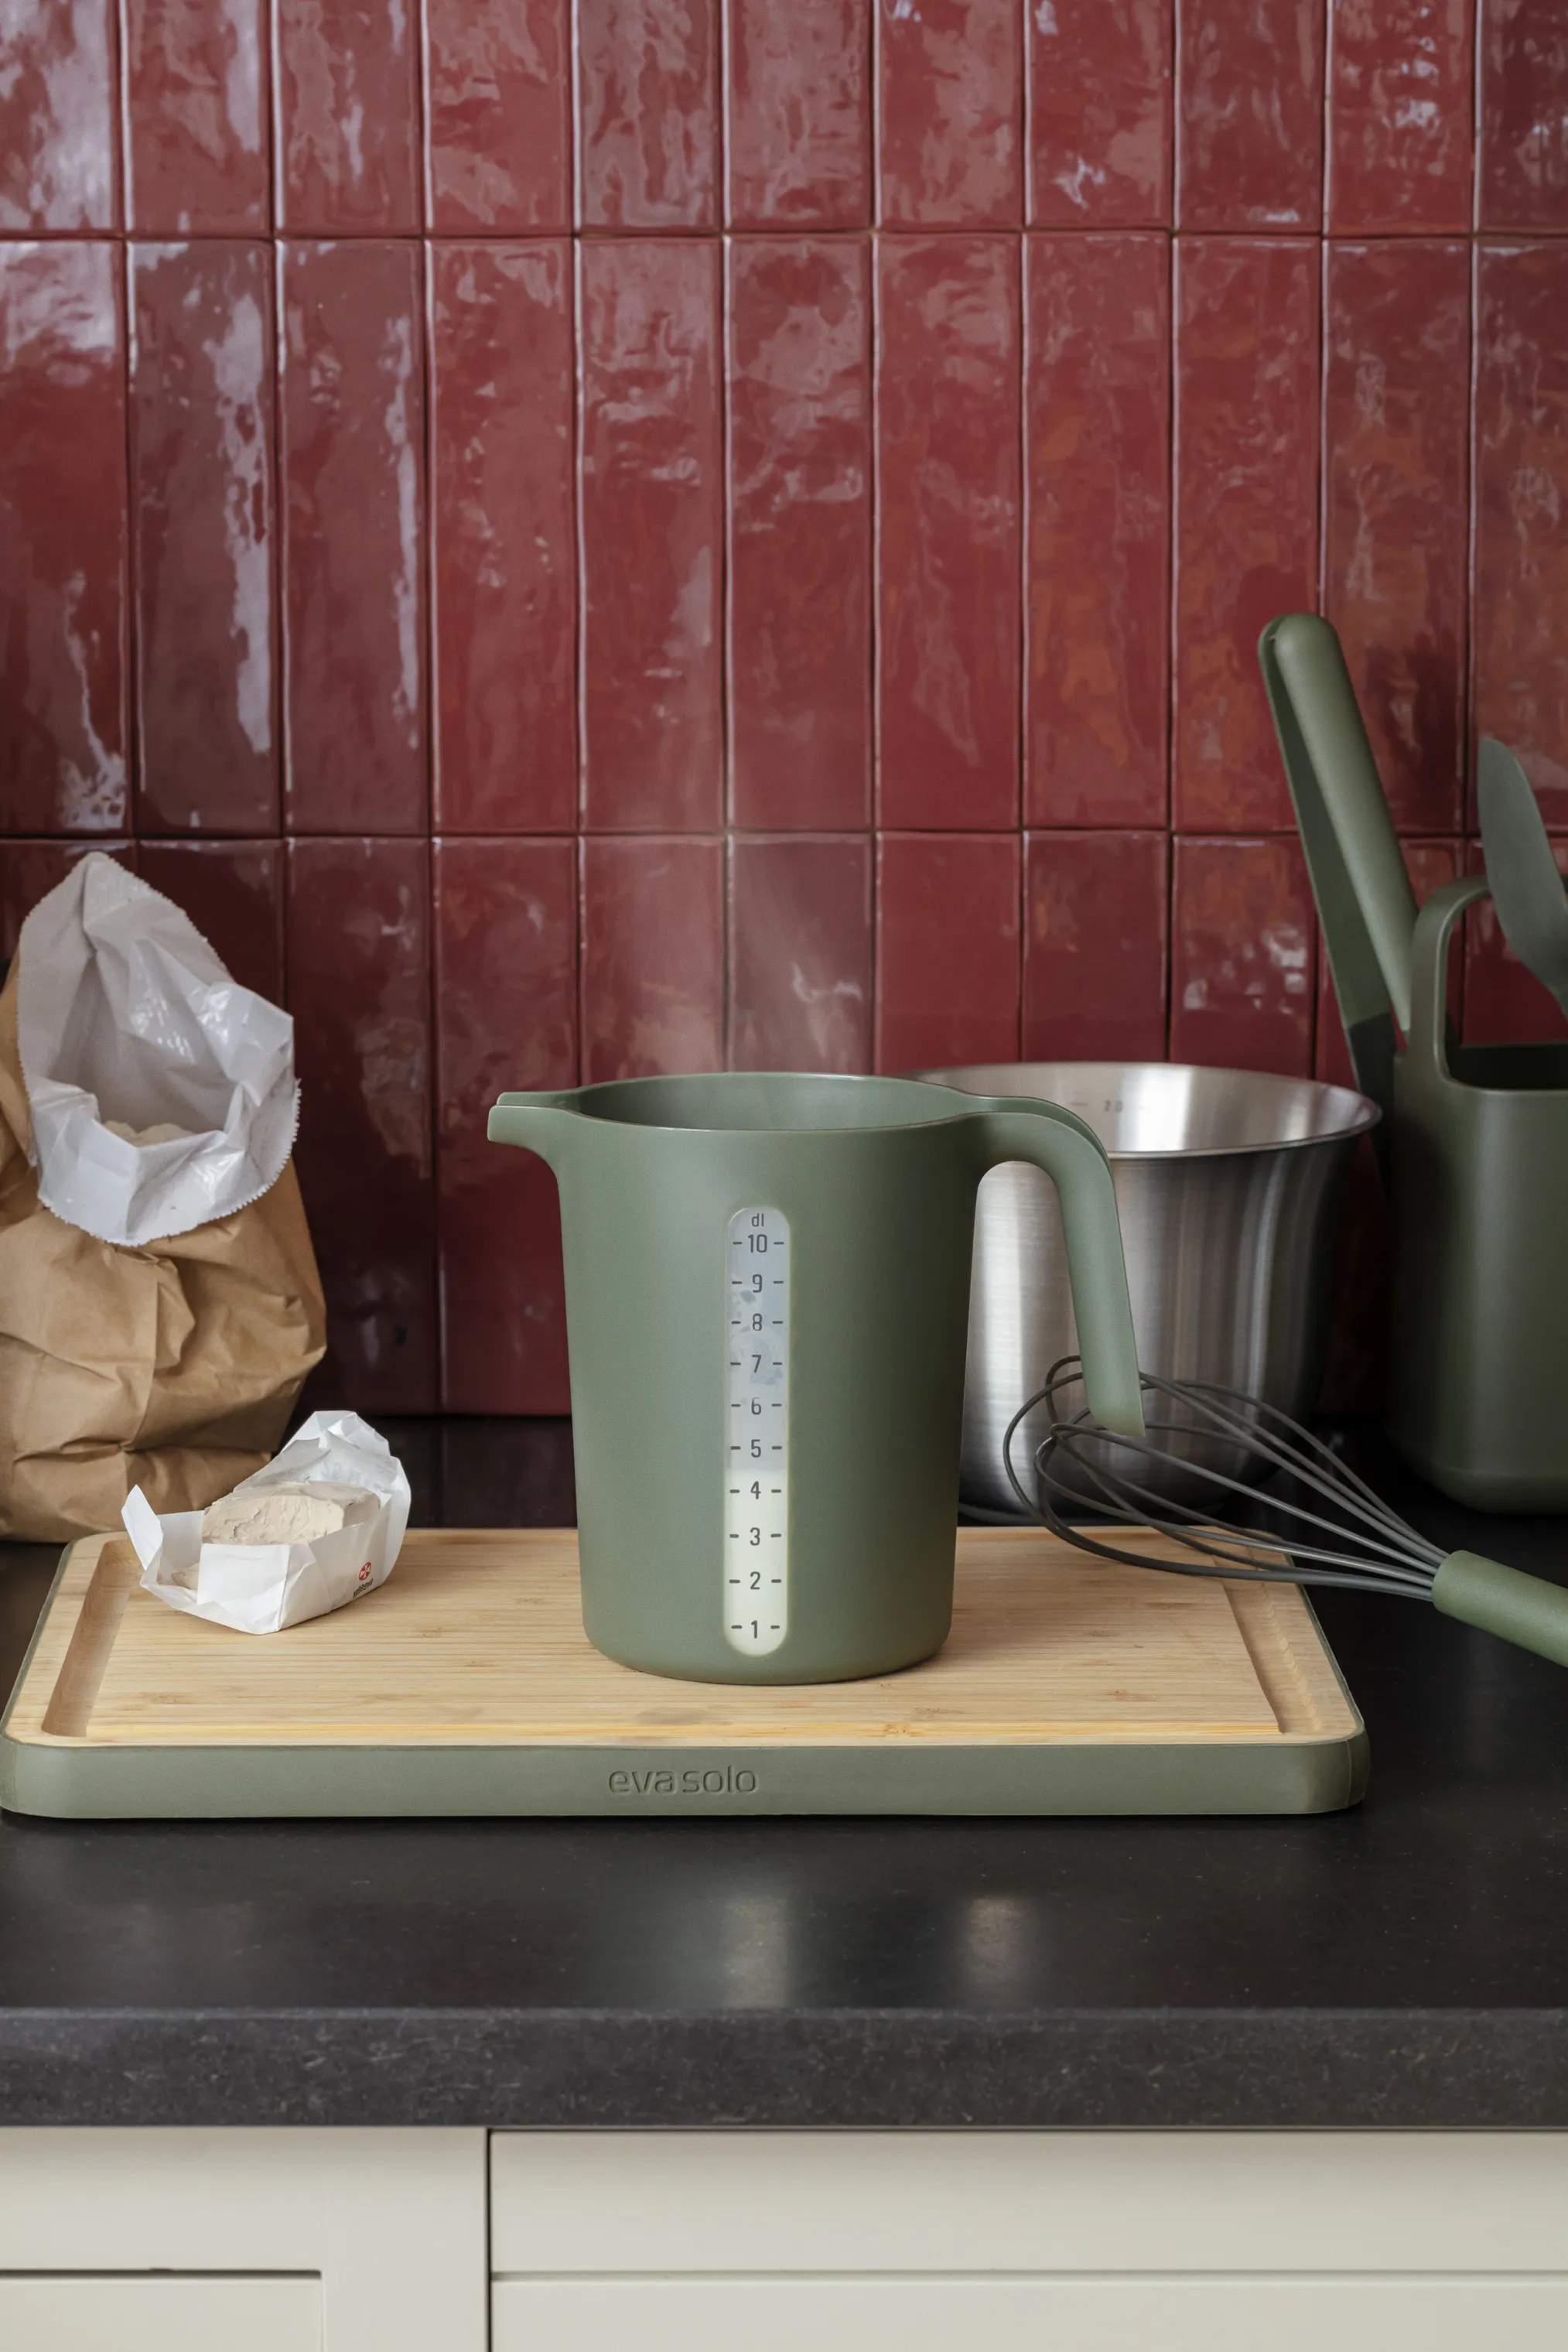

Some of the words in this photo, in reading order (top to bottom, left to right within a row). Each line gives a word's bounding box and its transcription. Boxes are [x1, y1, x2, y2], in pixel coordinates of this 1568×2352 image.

[752, 1212, 765, 1228] dl
[747, 1234, 768, 1253] 10
[752, 1274, 763, 1294] 9
[752, 1313, 763, 1332] 8
[751, 1354, 762, 1373] 7
[750, 1397, 762, 1416] 6
[750, 1439, 762, 1458] 5
[750, 1481, 762, 1500] 4
[750, 1526, 760, 1547] 3
[750, 1571, 760, 1591] 2
[750, 1620, 758, 1639] 1
